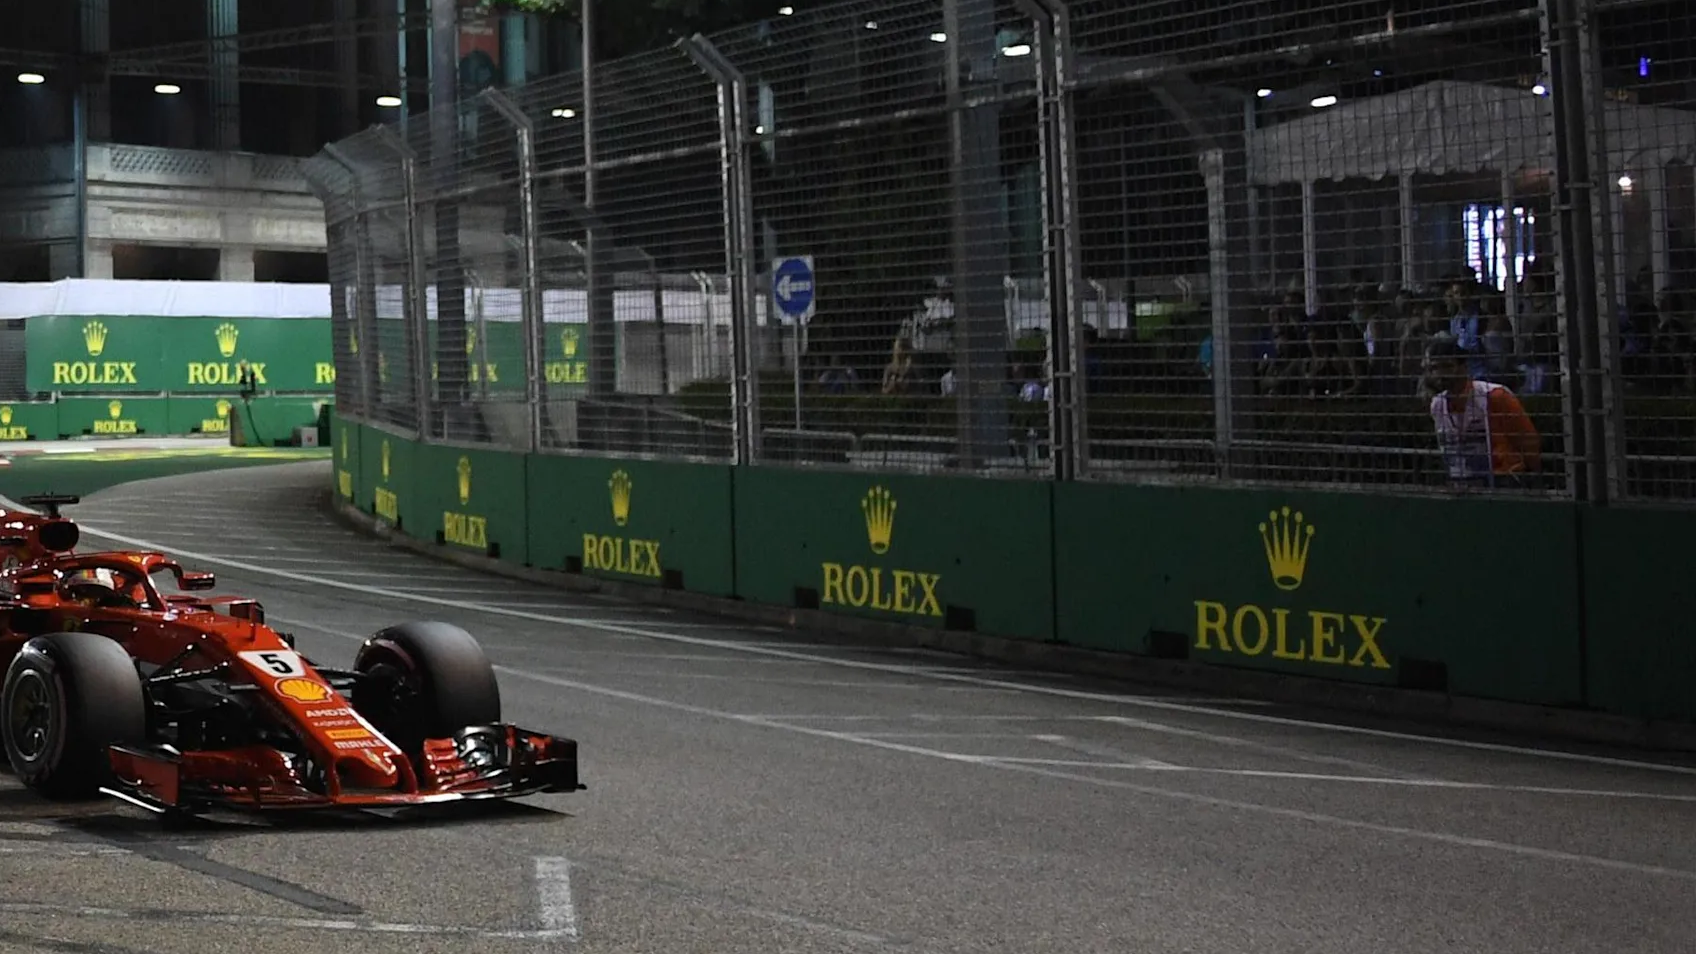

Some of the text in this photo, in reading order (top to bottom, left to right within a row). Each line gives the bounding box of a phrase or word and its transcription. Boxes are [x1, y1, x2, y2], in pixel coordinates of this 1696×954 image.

[53, 362, 138, 385] ROLEX
[94, 419, 137, 433] ROLEX
[203, 419, 230, 432] ROL
[443, 511, 487, 548] ROLEX
[582, 533, 662, 577] ROLEX
[821, 561, 943, 617] ROLEX
[1193, 600, 1392, 669] ROLEX
[259, 653, 293, 674] 5
